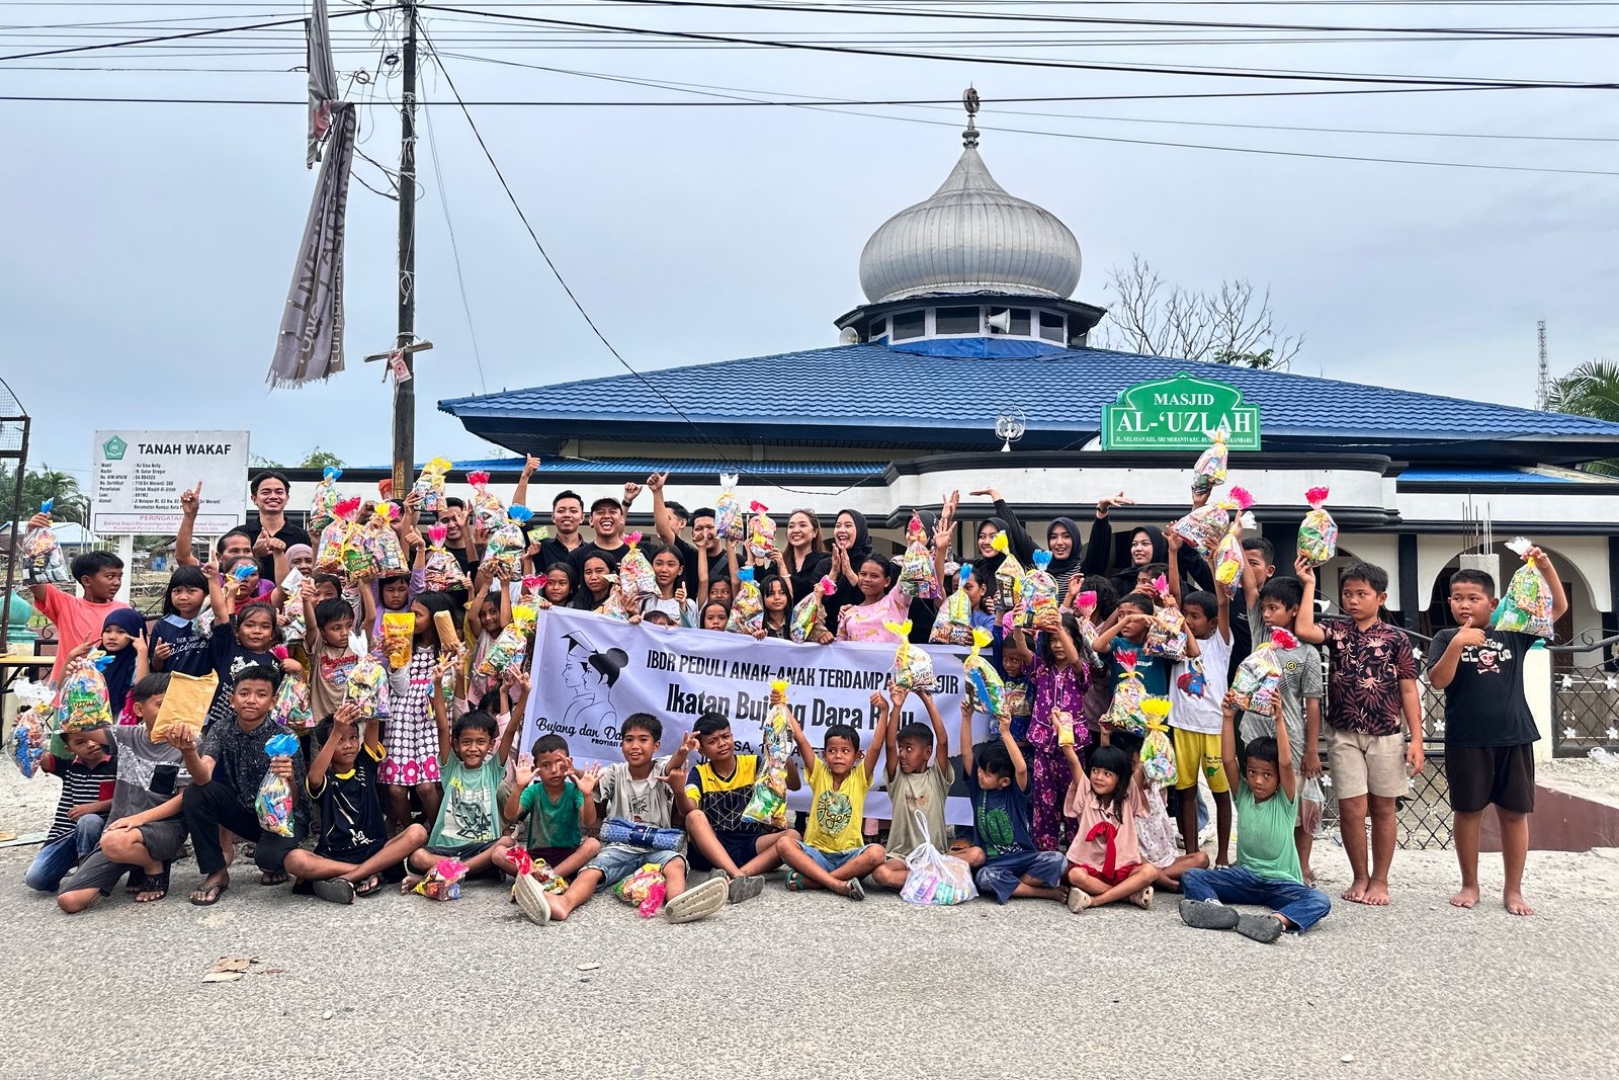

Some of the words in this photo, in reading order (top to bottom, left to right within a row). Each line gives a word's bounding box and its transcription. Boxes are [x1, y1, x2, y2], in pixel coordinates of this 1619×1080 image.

[1154, 393, 1215, 406] MASJID
[138, 444, 182, 455] TANAH
[186, 444, 232, 455] WAKAF
[646, 649, 677, 672] IBDR
[678, 654, 728, 678] PEDULI
[729, 661, 816, 687] ANAK-ANAK
[819, 668, 893, 691] TERDAMPA
[666, 683, 730, 719] Ikatan
[735, 691, 807, 731] Bujng
[811, 698, 863, 730] Dara
[535, 717, 577, 737] Bujang
[579, 723, 600, 738] dan
